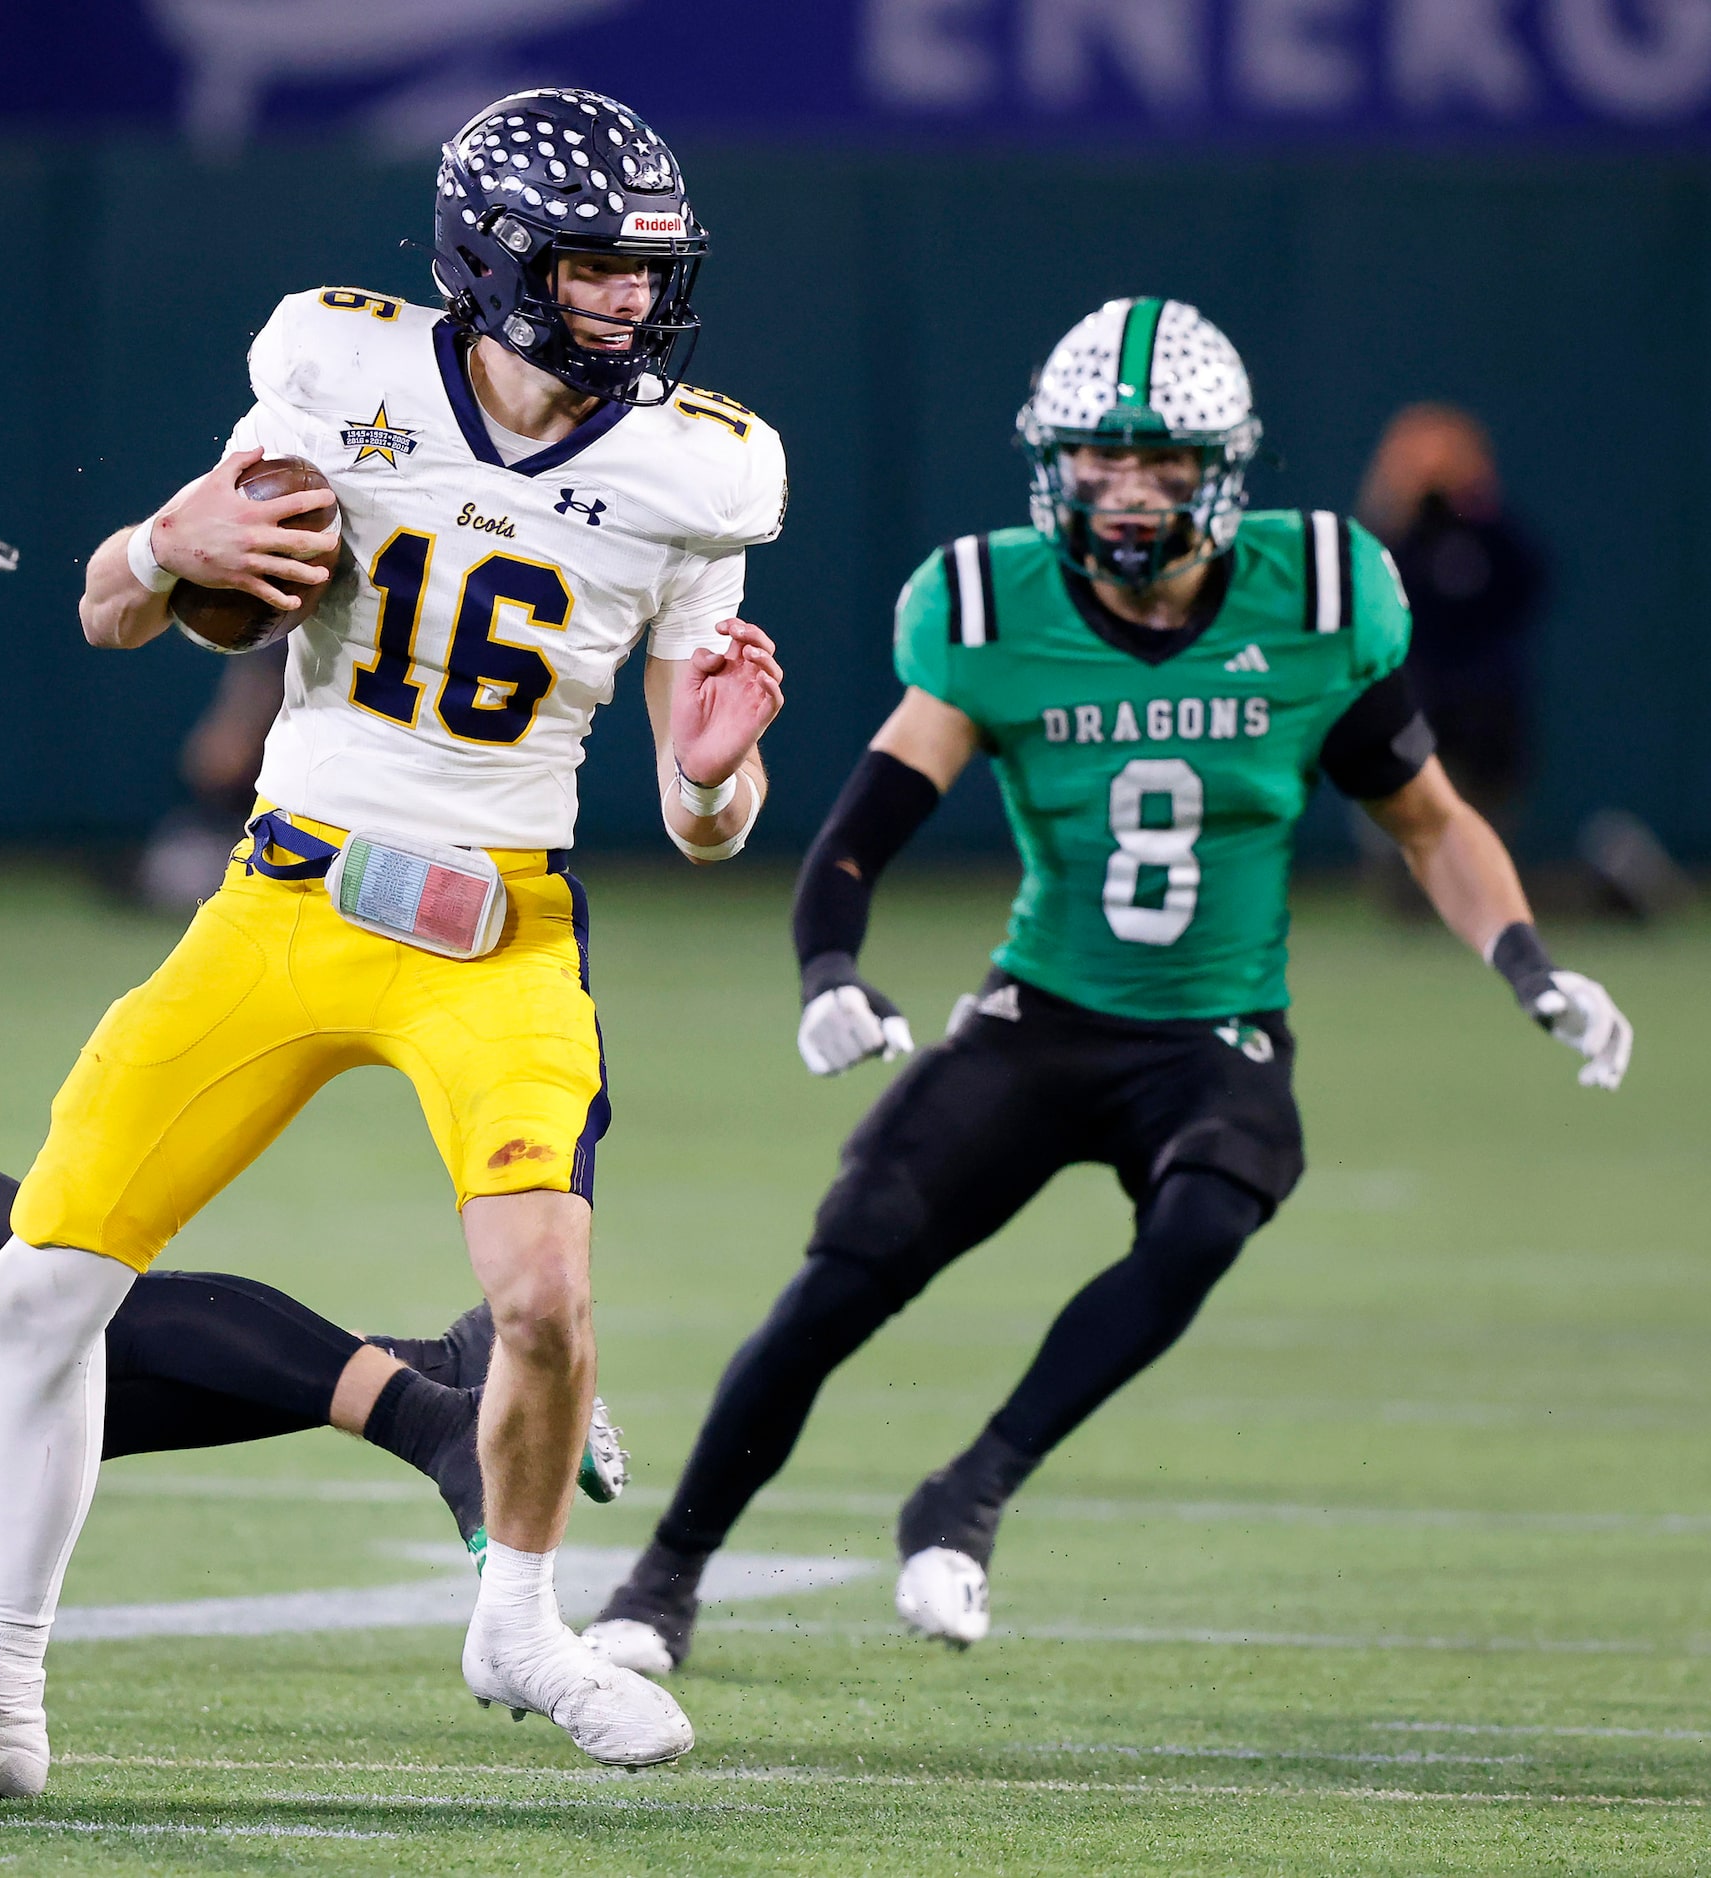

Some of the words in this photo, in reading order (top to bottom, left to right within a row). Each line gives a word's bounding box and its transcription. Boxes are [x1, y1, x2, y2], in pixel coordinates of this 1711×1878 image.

[635, 218, 681, 231] Riddell
[456, 502, 515, 538] Scots
[348, 525, 575, 746] 16
[1042, 697, 1271, 744] DRAGONS
[1102, 758, 1204, 947] 8
